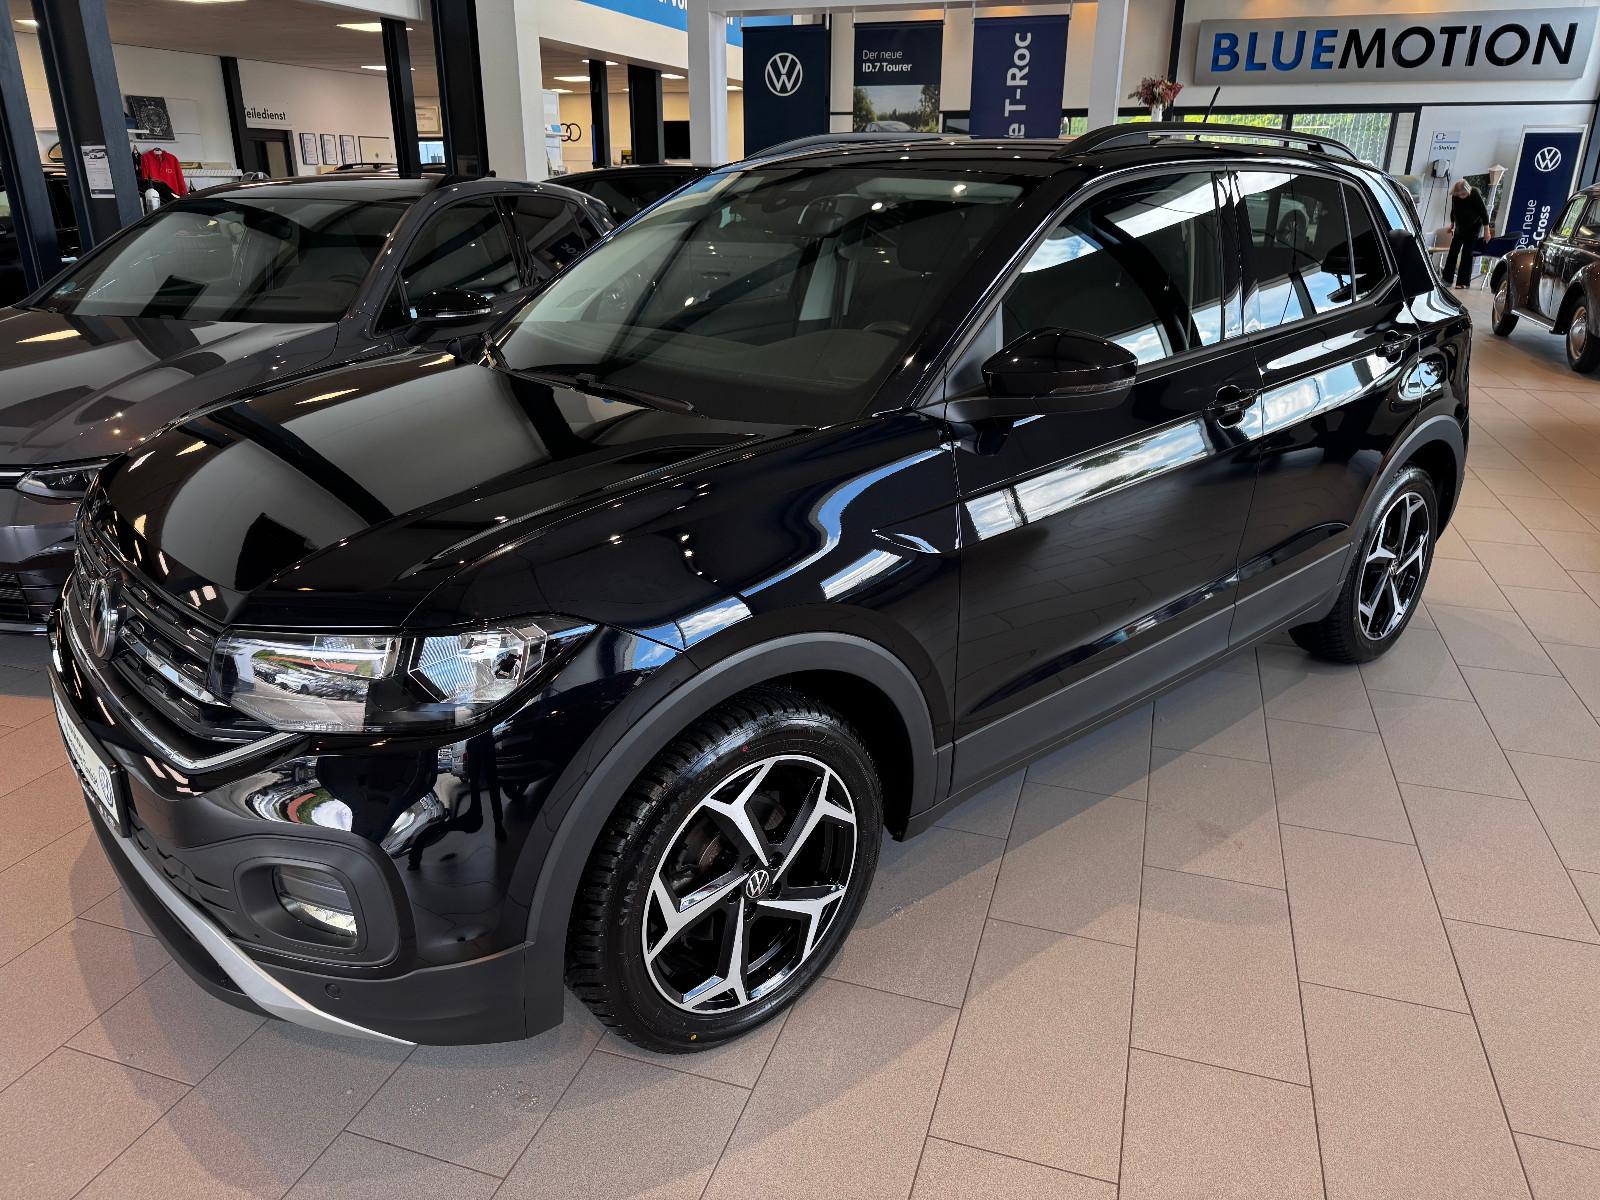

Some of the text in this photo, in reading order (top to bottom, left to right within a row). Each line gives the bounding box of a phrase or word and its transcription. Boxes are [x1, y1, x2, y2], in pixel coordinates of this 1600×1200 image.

[862, 50, 903, 60] Der neue
[1210, 22, 1579, 73] BLUEMOTION
[862, 62, 913, 73] ID.7 Tourer
[1004, 32, 1032, 117] T-Roc
[245, 107, 287, 121] eiledienst
[1522, 199, 1537, 230] neue
